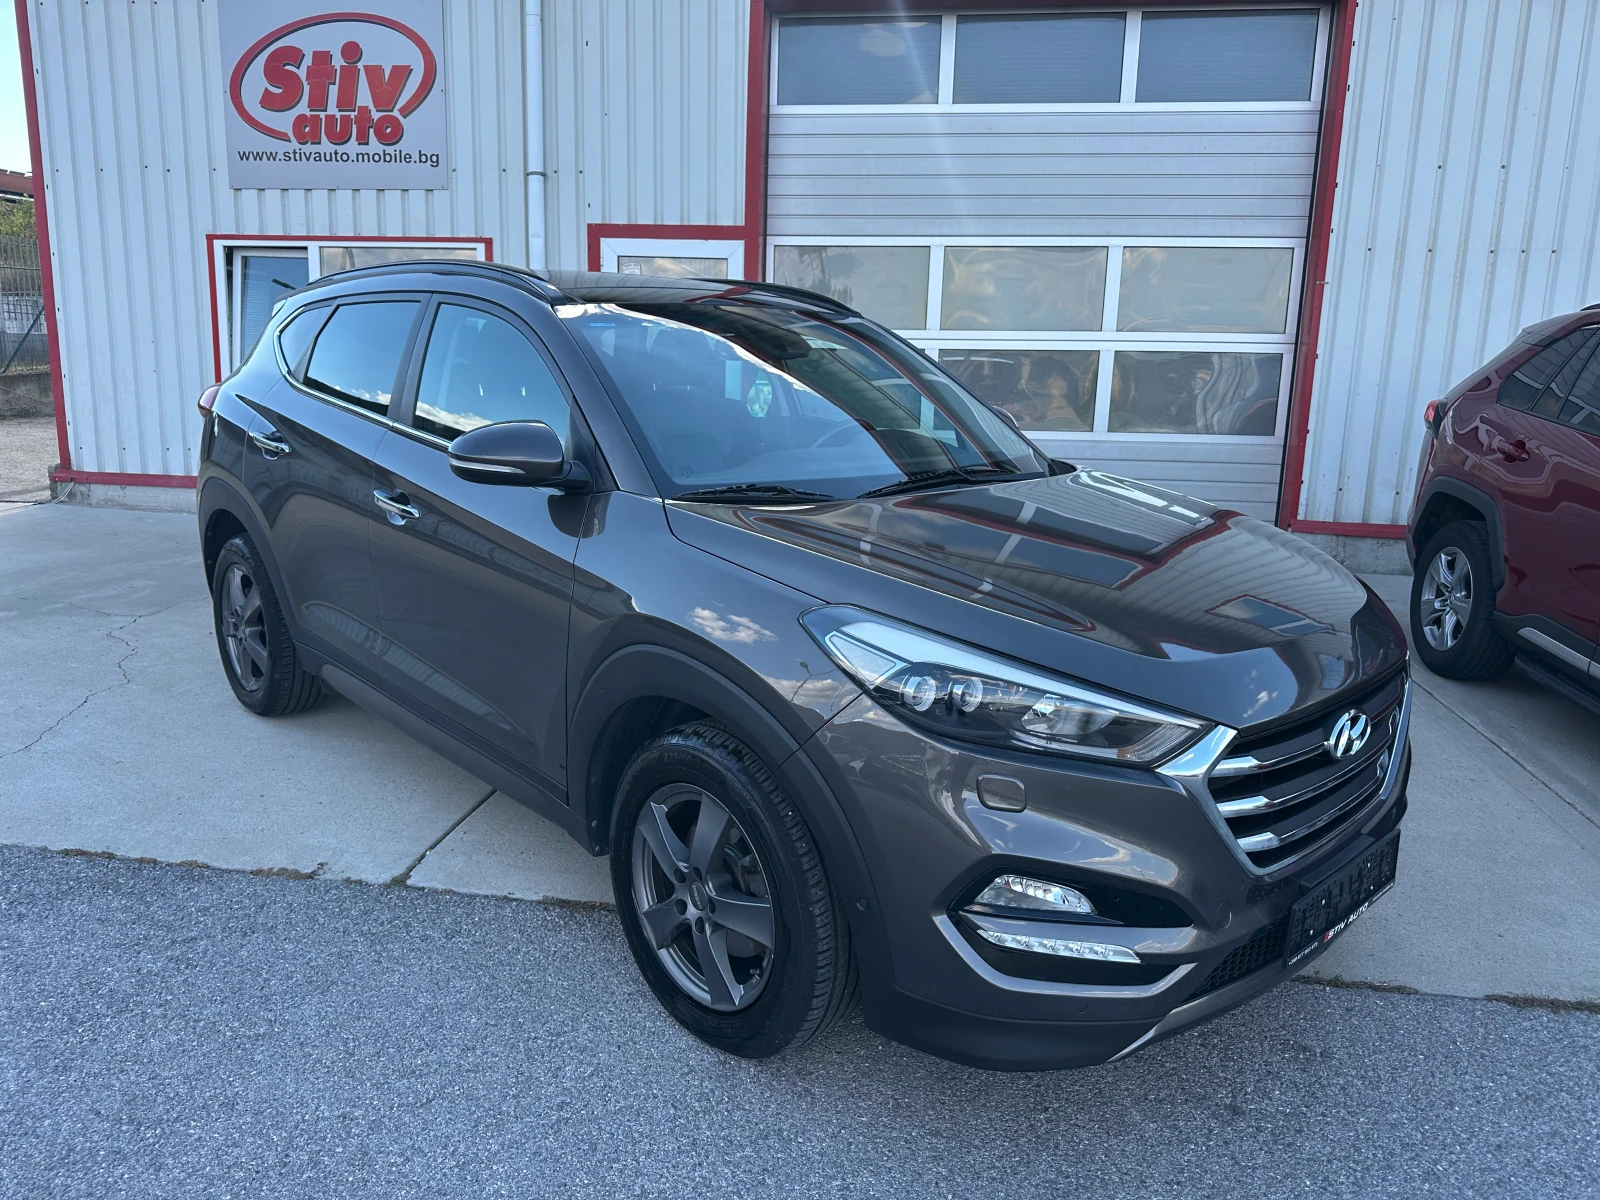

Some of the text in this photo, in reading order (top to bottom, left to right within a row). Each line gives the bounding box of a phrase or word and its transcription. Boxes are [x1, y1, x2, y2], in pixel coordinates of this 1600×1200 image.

[259, 41, 413, 111] Stiv
[292, 106, 404, 145] auto
[238, 148, 440, 167] www.stivauto.mobile.bg
[1347, 902, 1368, 924] AUTO
